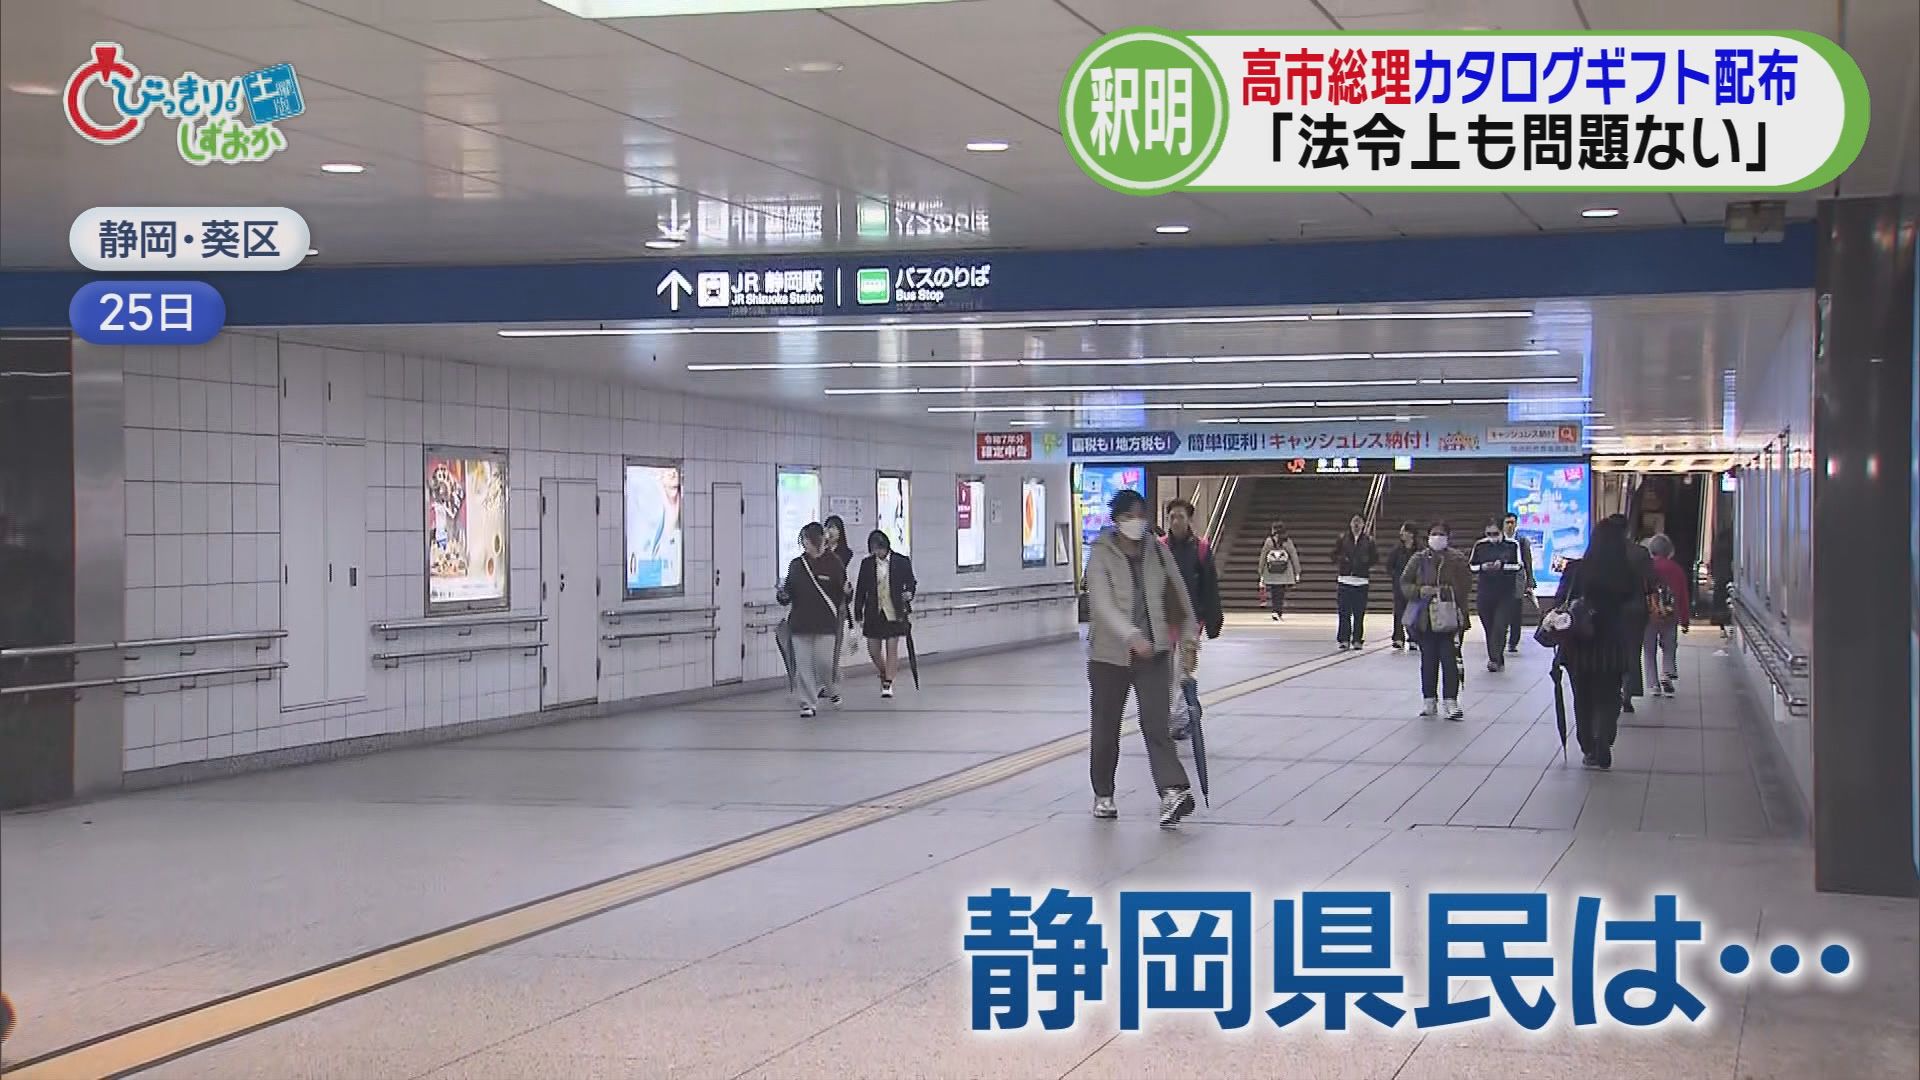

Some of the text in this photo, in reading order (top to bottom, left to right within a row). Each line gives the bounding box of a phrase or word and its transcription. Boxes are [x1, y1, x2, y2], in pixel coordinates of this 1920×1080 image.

[731, 269, 823, 293] JR 静岡駅
[895, 264, 991, 288] バスのりば
[731, 291, 824, 305] JR Shizuoka Station
[895, 288, 944, 302] Bus Stop
[981, 445, 1027, 459] 確定申告
